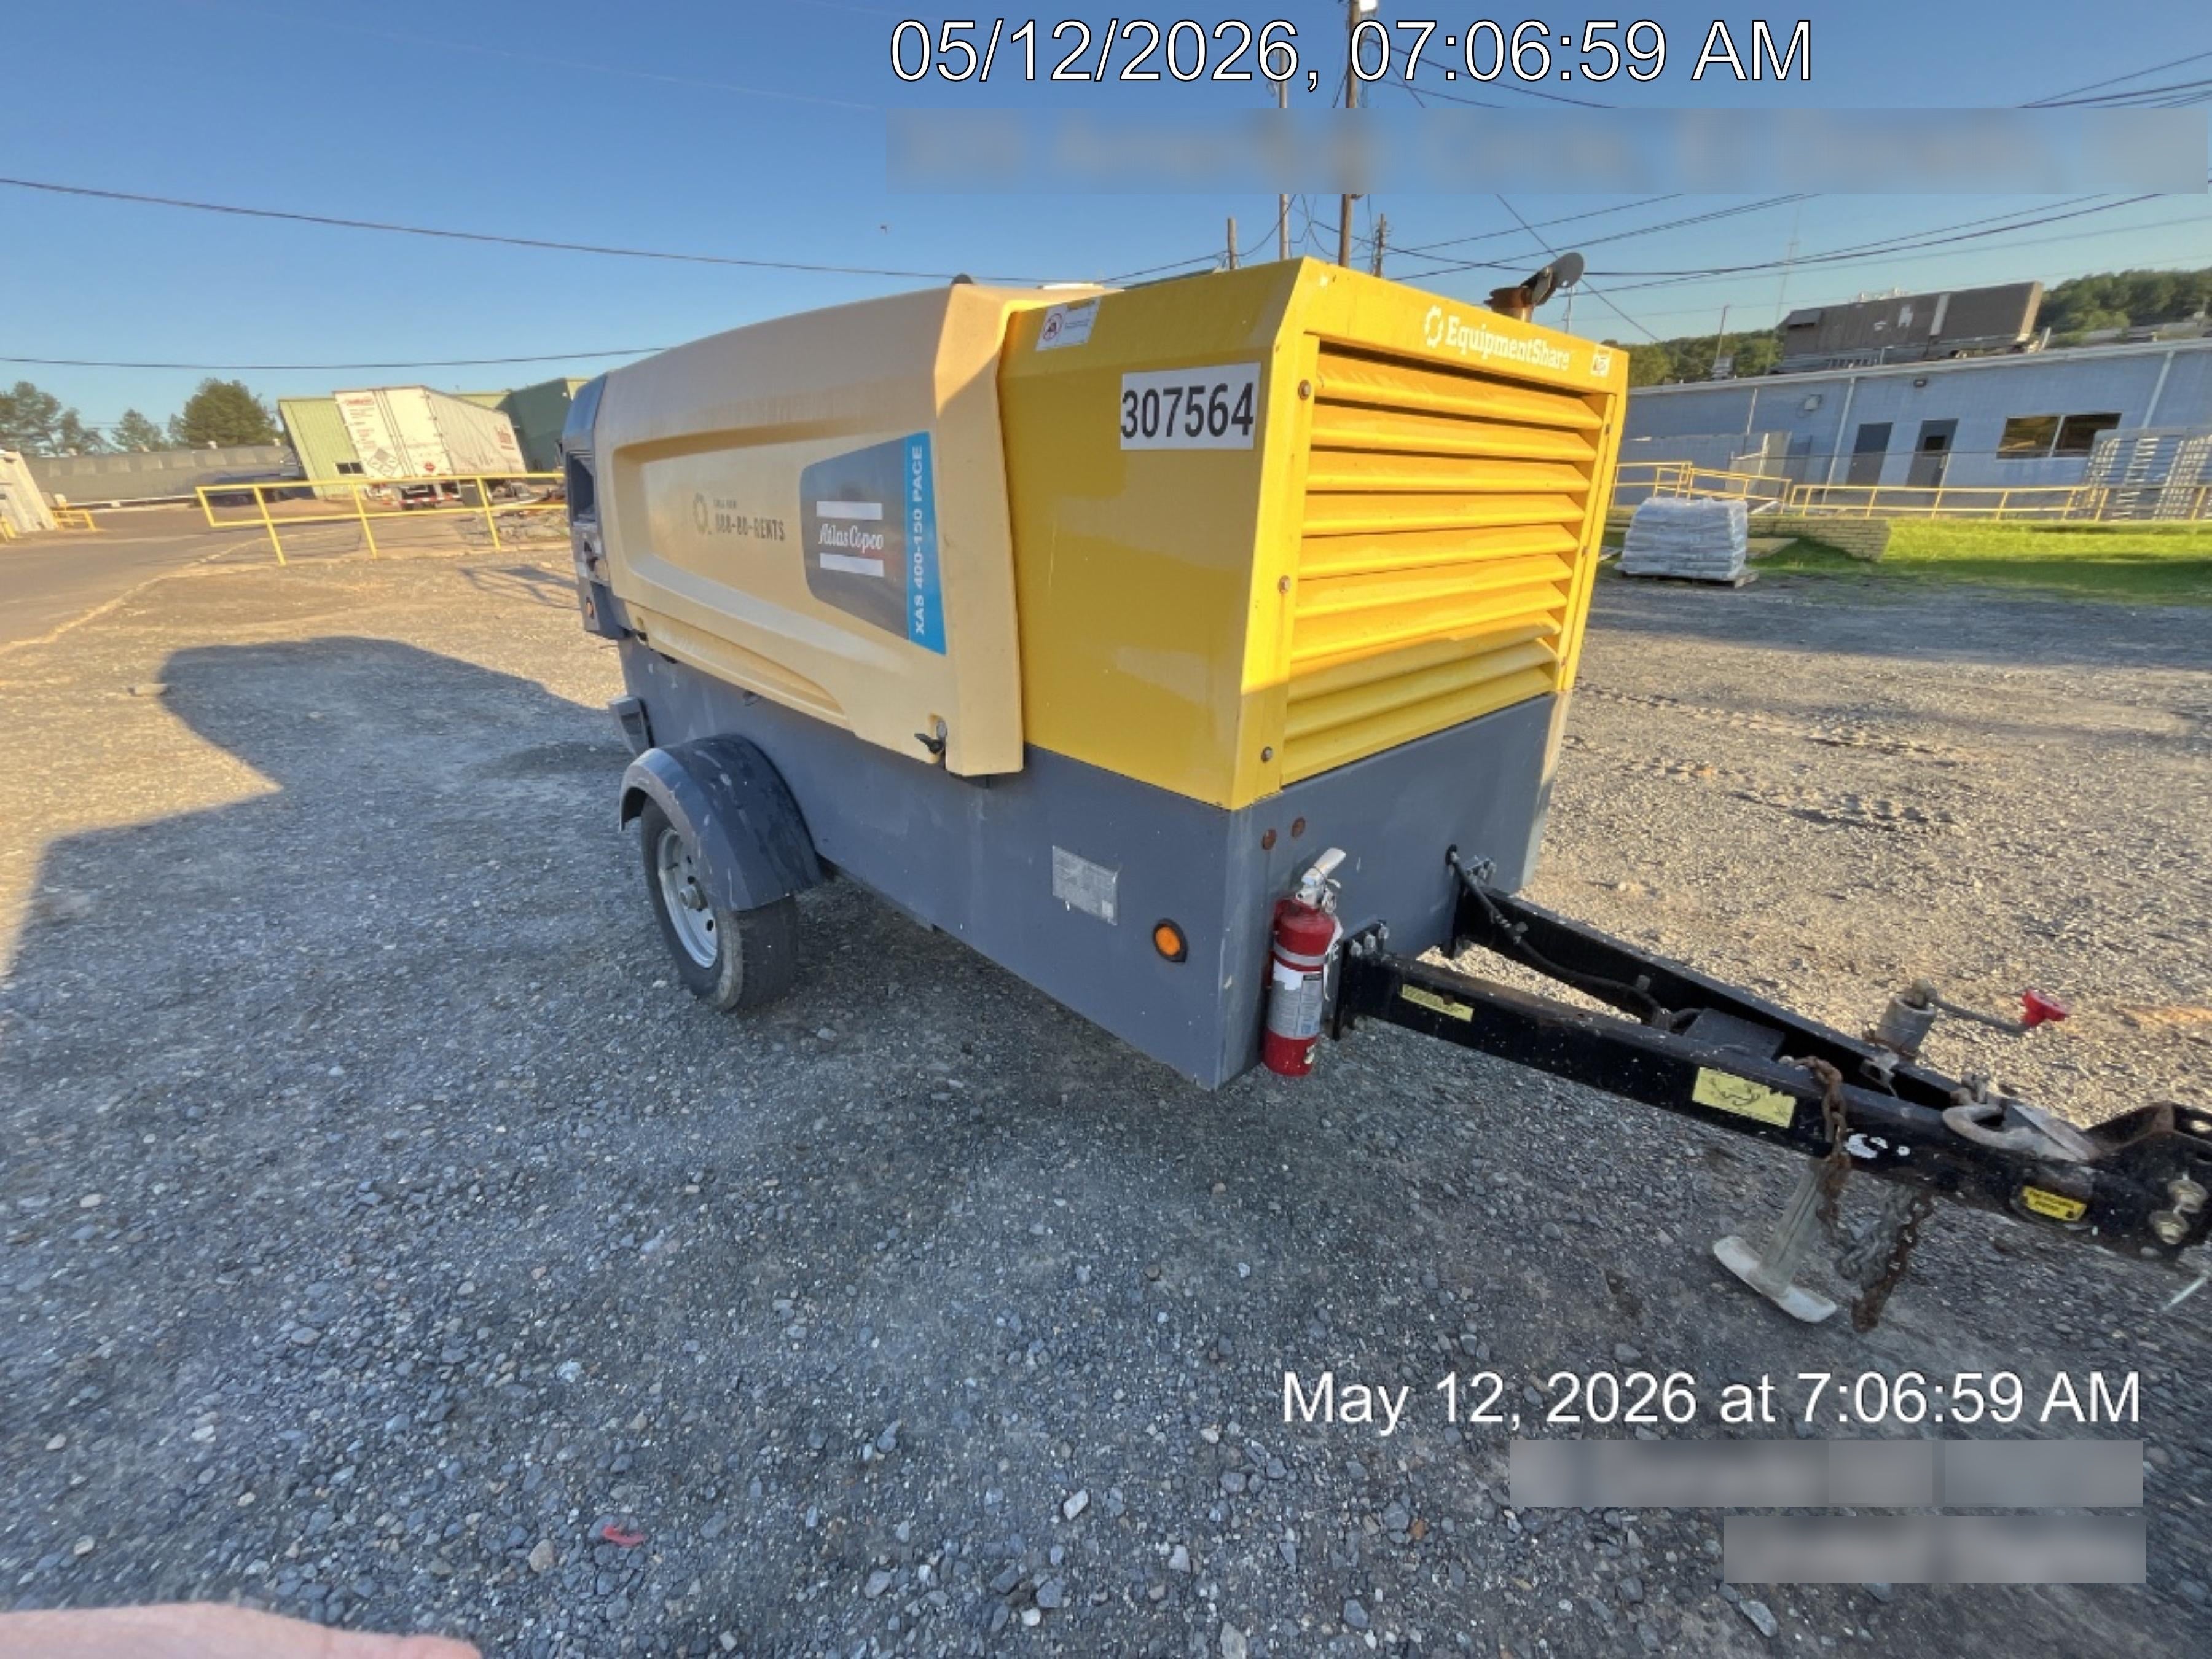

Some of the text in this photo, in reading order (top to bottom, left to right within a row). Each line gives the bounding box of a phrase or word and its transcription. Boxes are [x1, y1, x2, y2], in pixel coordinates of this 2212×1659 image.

[1445, 315, 1570, 371] EquipmentShare
[1121, 381, 1255, 439] 307564
[818, 522, 884, 554] Atlas Copco
[911, 445, 925, 635] XAS 400-150 PACE
